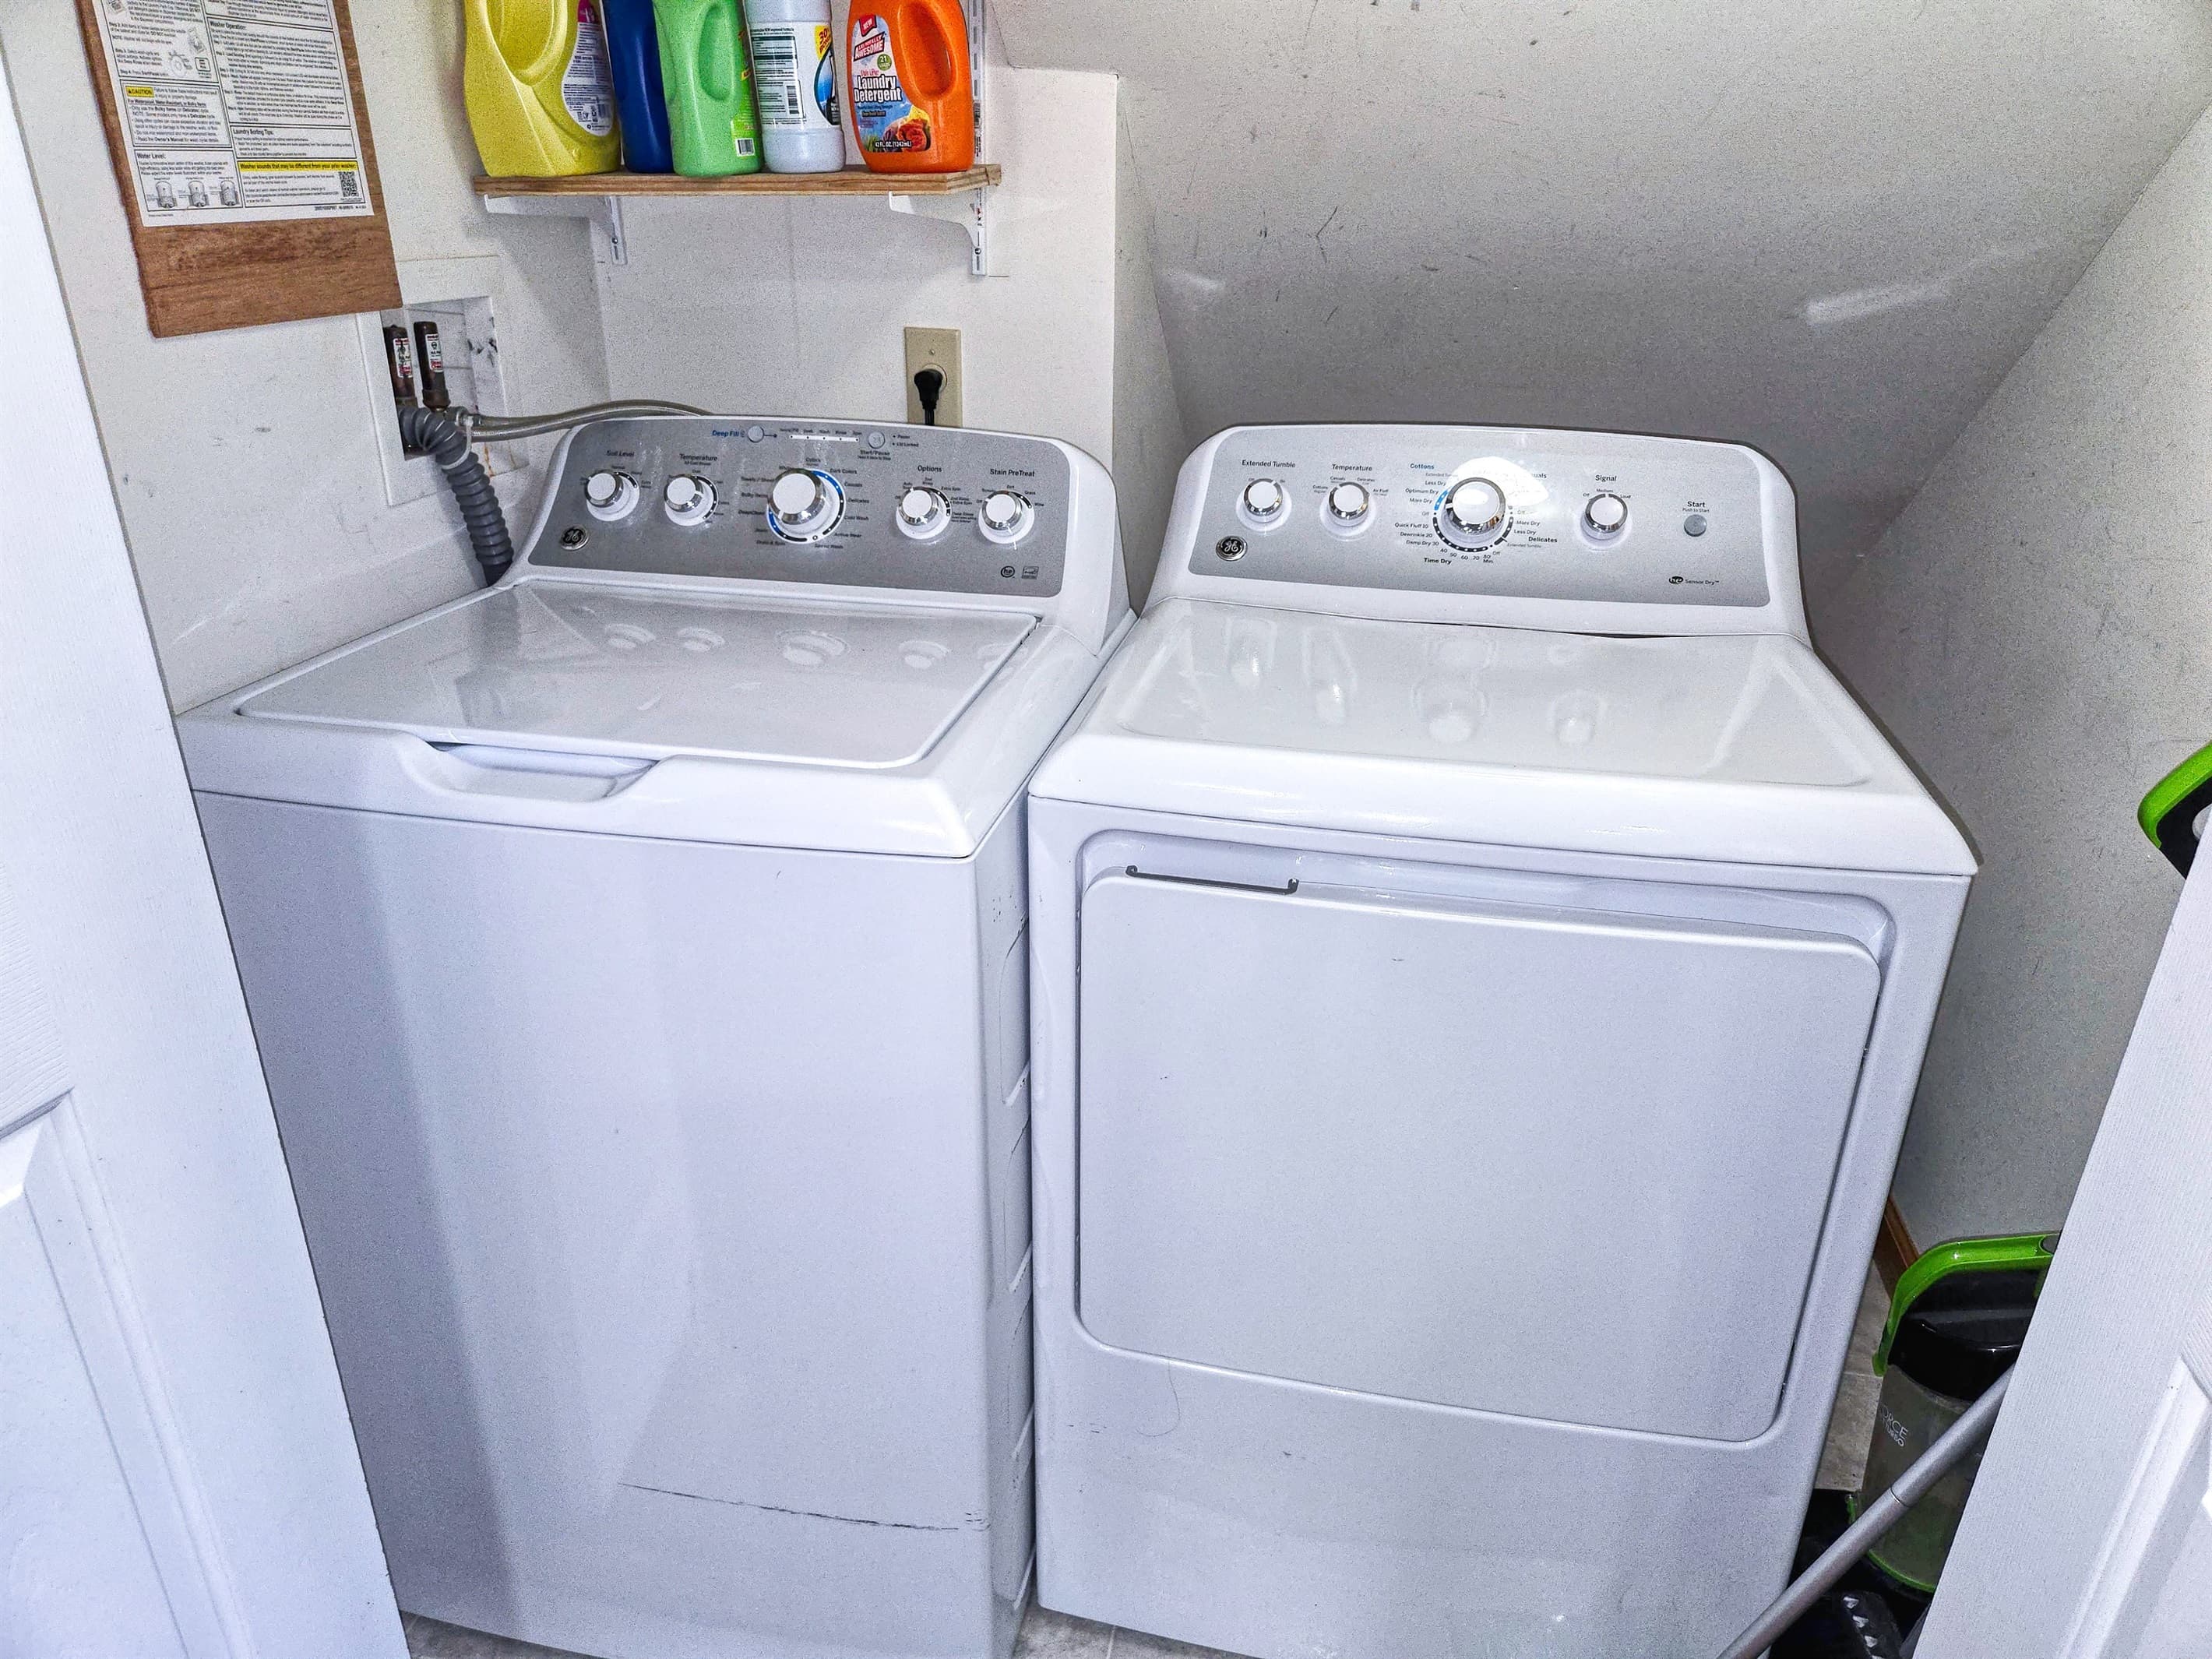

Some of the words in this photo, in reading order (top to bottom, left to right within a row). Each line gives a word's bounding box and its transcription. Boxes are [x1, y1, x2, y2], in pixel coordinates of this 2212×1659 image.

[854, 40, 883, 59] AWESOME
[858, 74, 896, 89] Laundry
[854, 88, 902, 102] Detergent
[1882, 1404, 1908, 1439] ORCE
